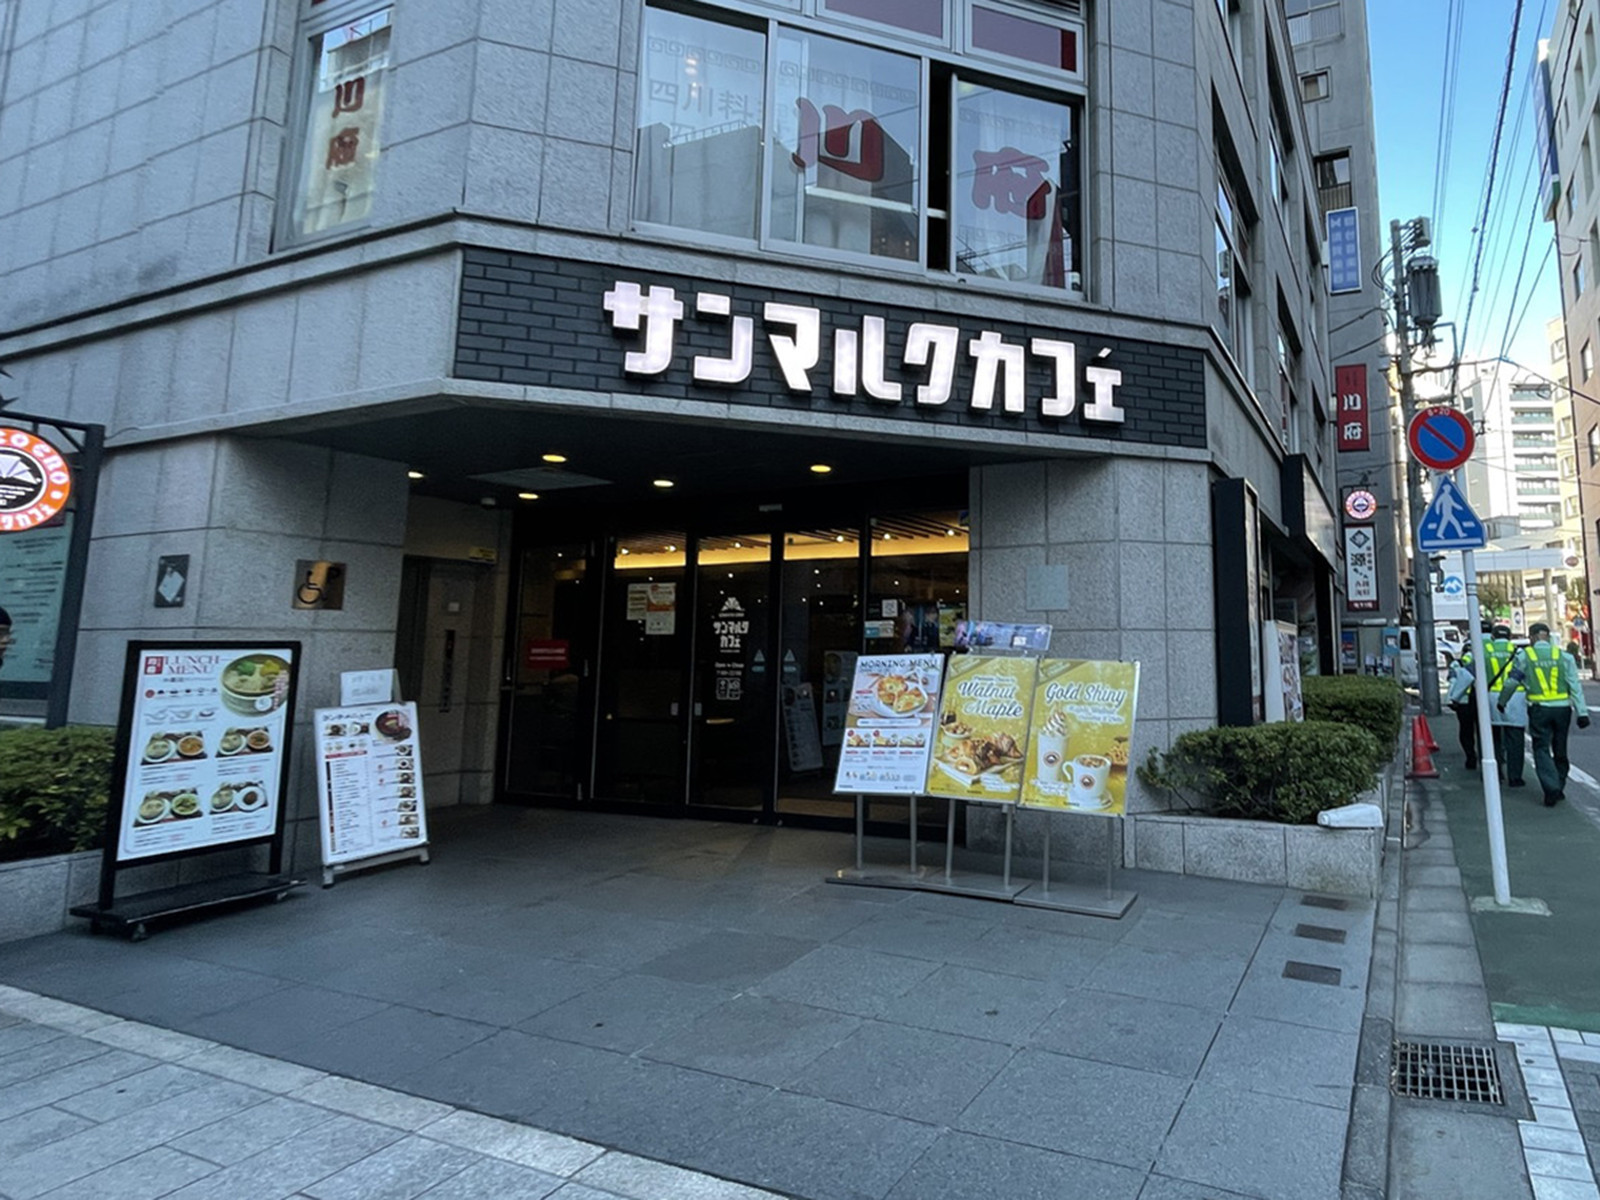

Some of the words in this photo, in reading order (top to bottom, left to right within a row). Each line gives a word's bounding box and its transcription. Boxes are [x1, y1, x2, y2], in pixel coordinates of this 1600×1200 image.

[649, 79, 762, 120] 四川料
[603, 280, 1126, 424] サンマルクカフェ
[163, 655, 219, 665] LUNCH
[168, 665, 214, 674] MENU
[860, 659, 906, 669] MORNING
[909, 659, 938, 669] MENU
[958, 681, 1017, 699] Walnut
[1046, 682, 1082, 704] Gold
[1085, 683, 1126, 708] Shiny
[963, 698, 1023, 718] Maple
